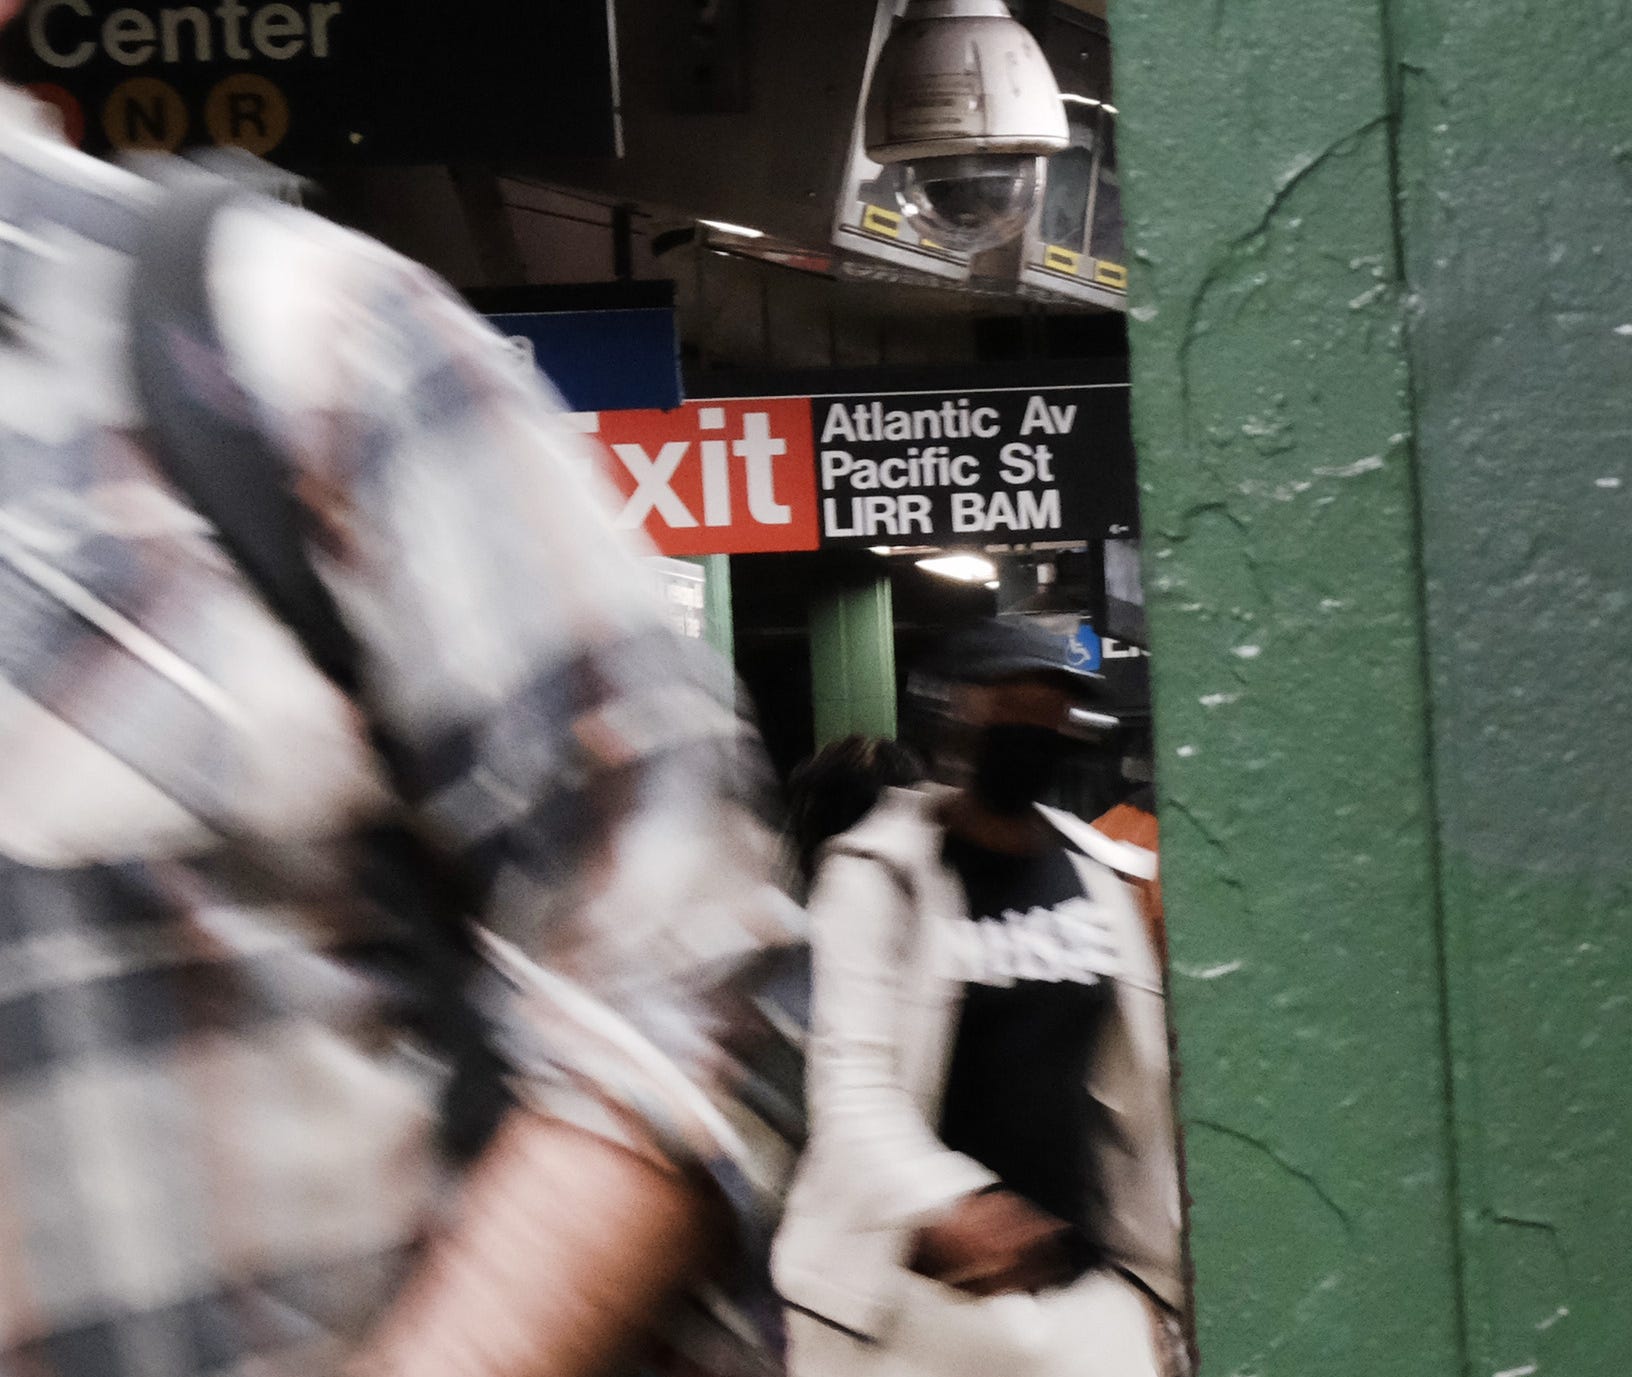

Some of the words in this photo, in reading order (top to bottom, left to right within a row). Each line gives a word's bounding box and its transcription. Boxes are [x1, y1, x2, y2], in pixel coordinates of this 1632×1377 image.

[27, 0, 342, 68] Center
[125, 96, 165, 140] N
[229, 92, 267, 138] R
[820, 398, 1001, 443] Atlantic
[1019, 395, 1078, 436] Av
[820, 446, 981, 490] Pacific
[999, 442, 1055, 485] St
[823, 494, 934, 537] LIRR
[950, 488, 1062, 533] BAM
